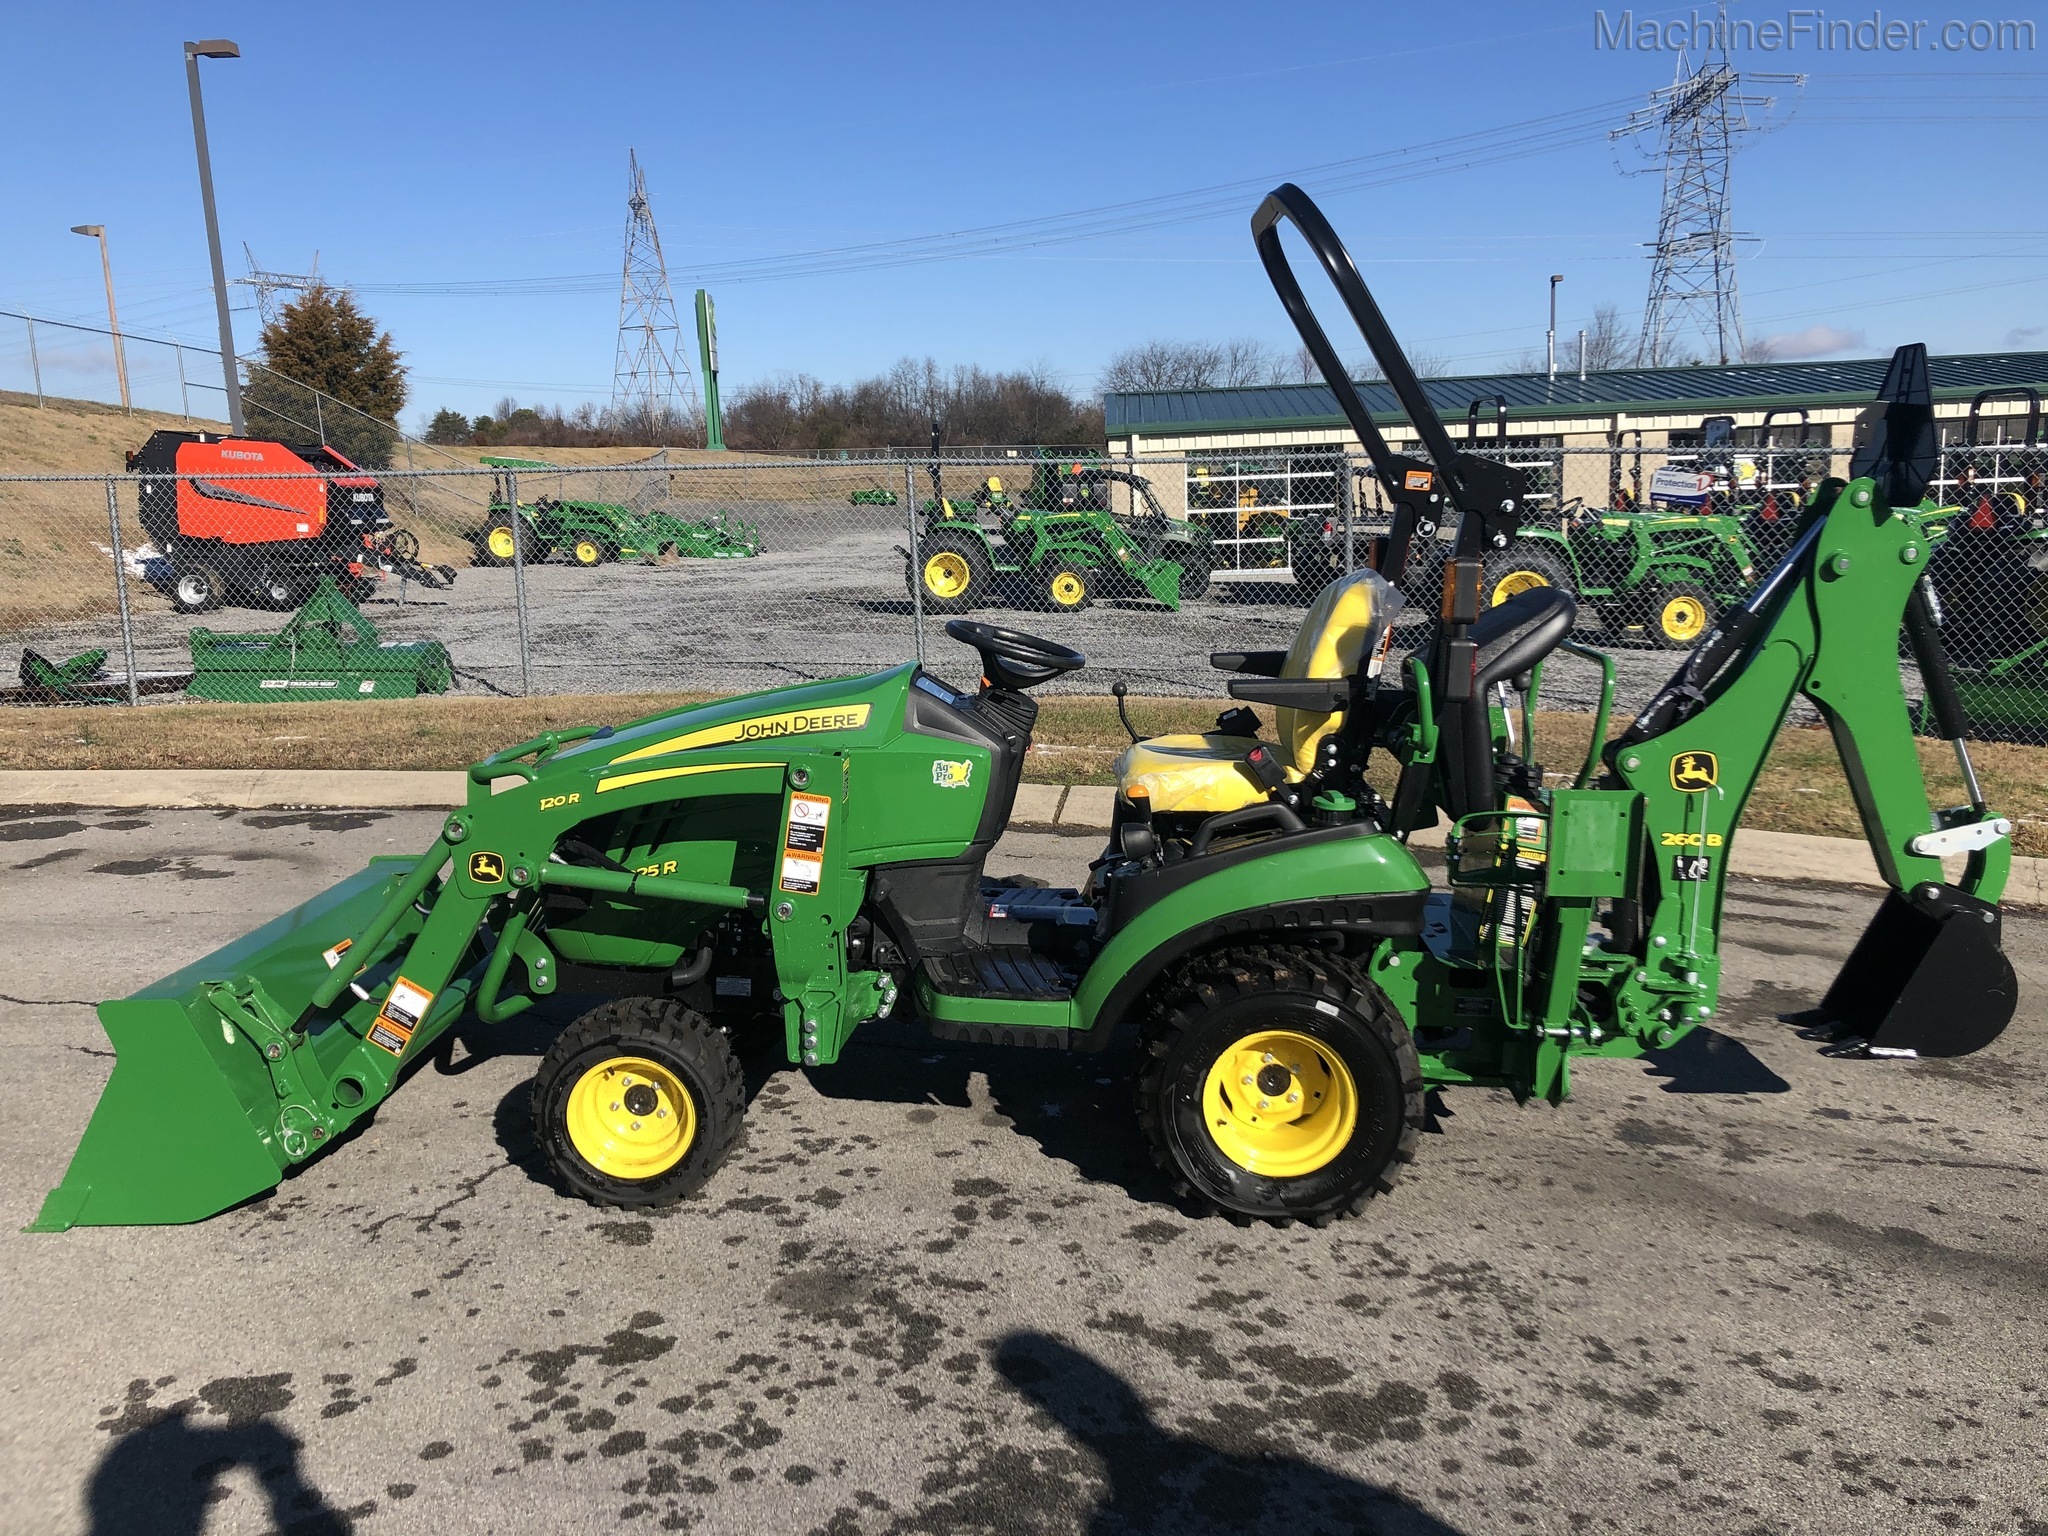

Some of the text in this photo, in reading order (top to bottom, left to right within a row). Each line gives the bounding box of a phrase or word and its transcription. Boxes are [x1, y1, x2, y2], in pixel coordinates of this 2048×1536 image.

[221, 449, 264, 462] KUBOTA
[1655, 477, 1697, 489] Protection
[352, 492, 374, 503] KUBOTA
[735, 713, 858, 740] JOHN DEERE
[935, 772, 953, 781] Pro
[539, 792, 581, 811] 120 R
[800, 794, 829, 803] WARNING
[1706, 833, 1723, 847] B
[791, 852, 821, 862] WARNING
[631, 859, 678, 877] 25 R
